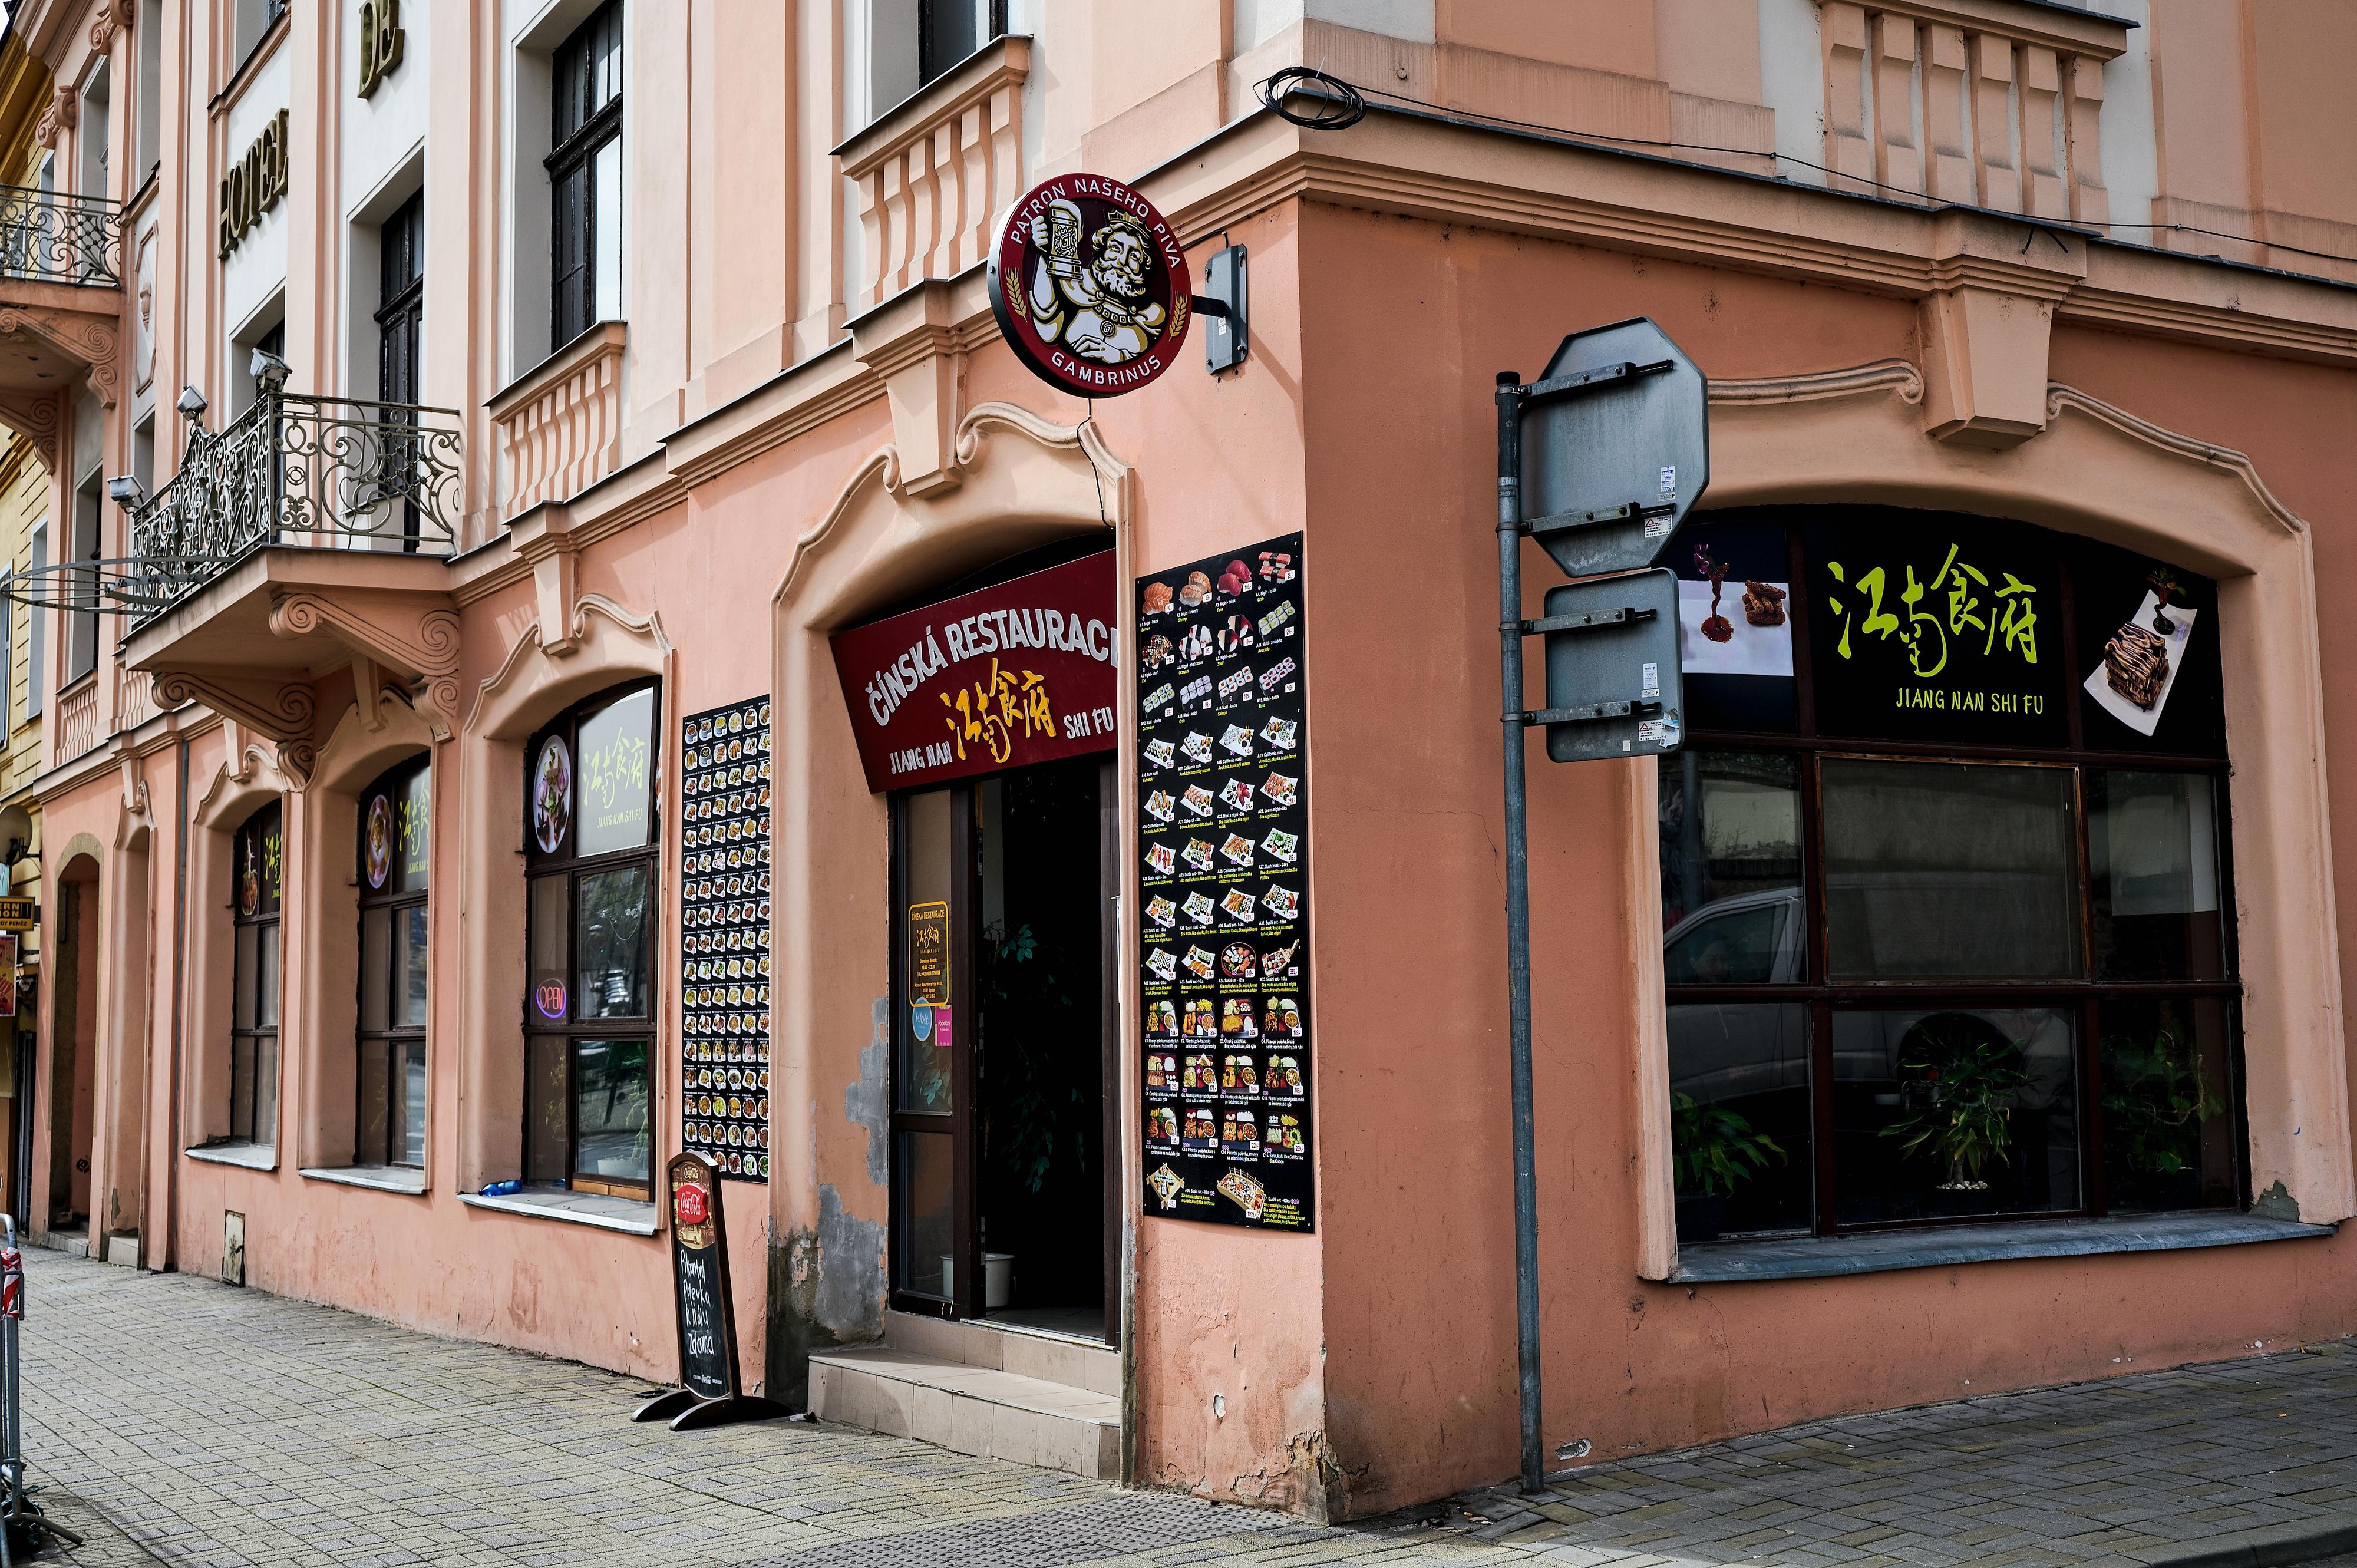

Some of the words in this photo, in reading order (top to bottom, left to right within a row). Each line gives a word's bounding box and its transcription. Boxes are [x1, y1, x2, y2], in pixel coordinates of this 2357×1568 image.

[218, 108, 289, 259] HOTEL
[1010, 183, 1066, 245] PATRON
[1075, 178, 1149, 219] NAŠEHO
[1153, 222, 1181, 269] PIVA
[1051, 352, 1161, 387] GAMBRINUS
[864, 625, 948, 726] ČÍNSKÁ
[1896, 688, 1945, 709] JIANG
[1952, 691, 1984, 712] NAN
[1991, 693, 2016, 714] SHI
[2023, 695, 2044, 714] FU
[890, 747, 925, 774] JIANG
[927, 741, 953, 767] NAN
[1063, 711, 1090, 740] SHI
[1092, 707, 1114, 735] FU
[597, 816, 612, 828] JIANG
[613, 813, 623, 826] NAN
[625, 810, 633, 823] SHI
[635, 807, 642, 820] FU
[923, 909, 945, 919] RESTAURACE
[539, 986, 563, 1010] OPEN
[916, 1012, 929, 1025] Wolt
